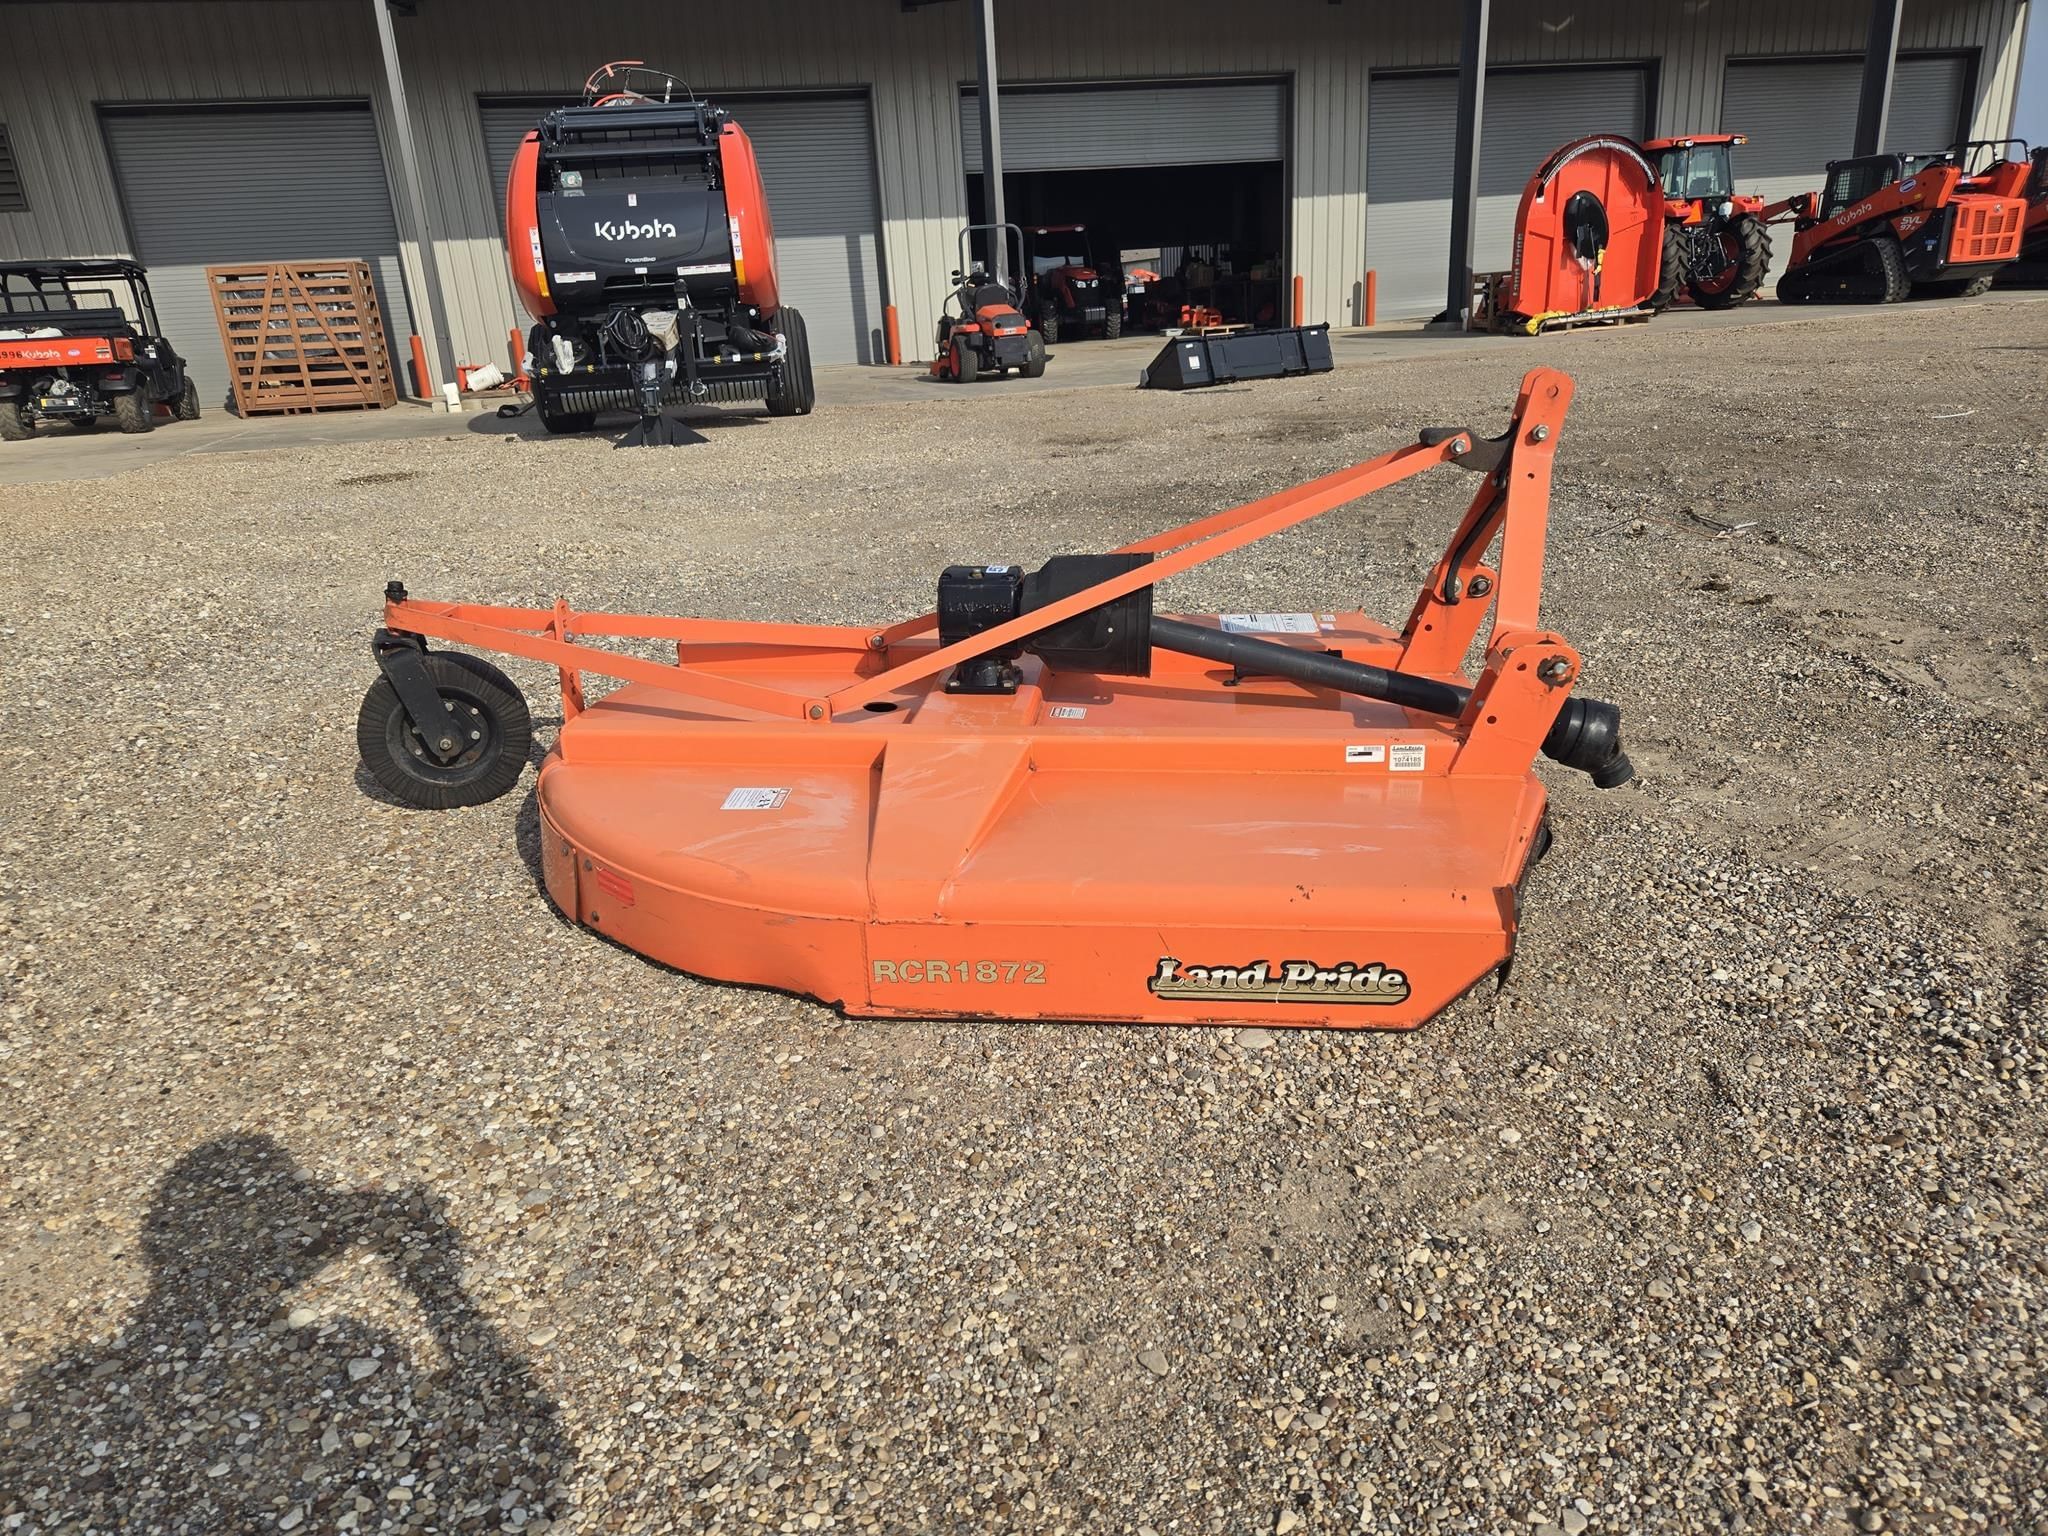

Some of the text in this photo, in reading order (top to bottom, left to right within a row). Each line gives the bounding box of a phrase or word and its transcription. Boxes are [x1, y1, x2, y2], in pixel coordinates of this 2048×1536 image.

[1836, 202, 1873, 226] Kubota
[1900, 216, 1923, 225] SVL
[594, 218, 677, 241] Kubota
[22, 349, 61, 360] Kubota
[872, 959, 1047, 985] RCR1872
[1153, 957, 1405, 994] Land Pride
